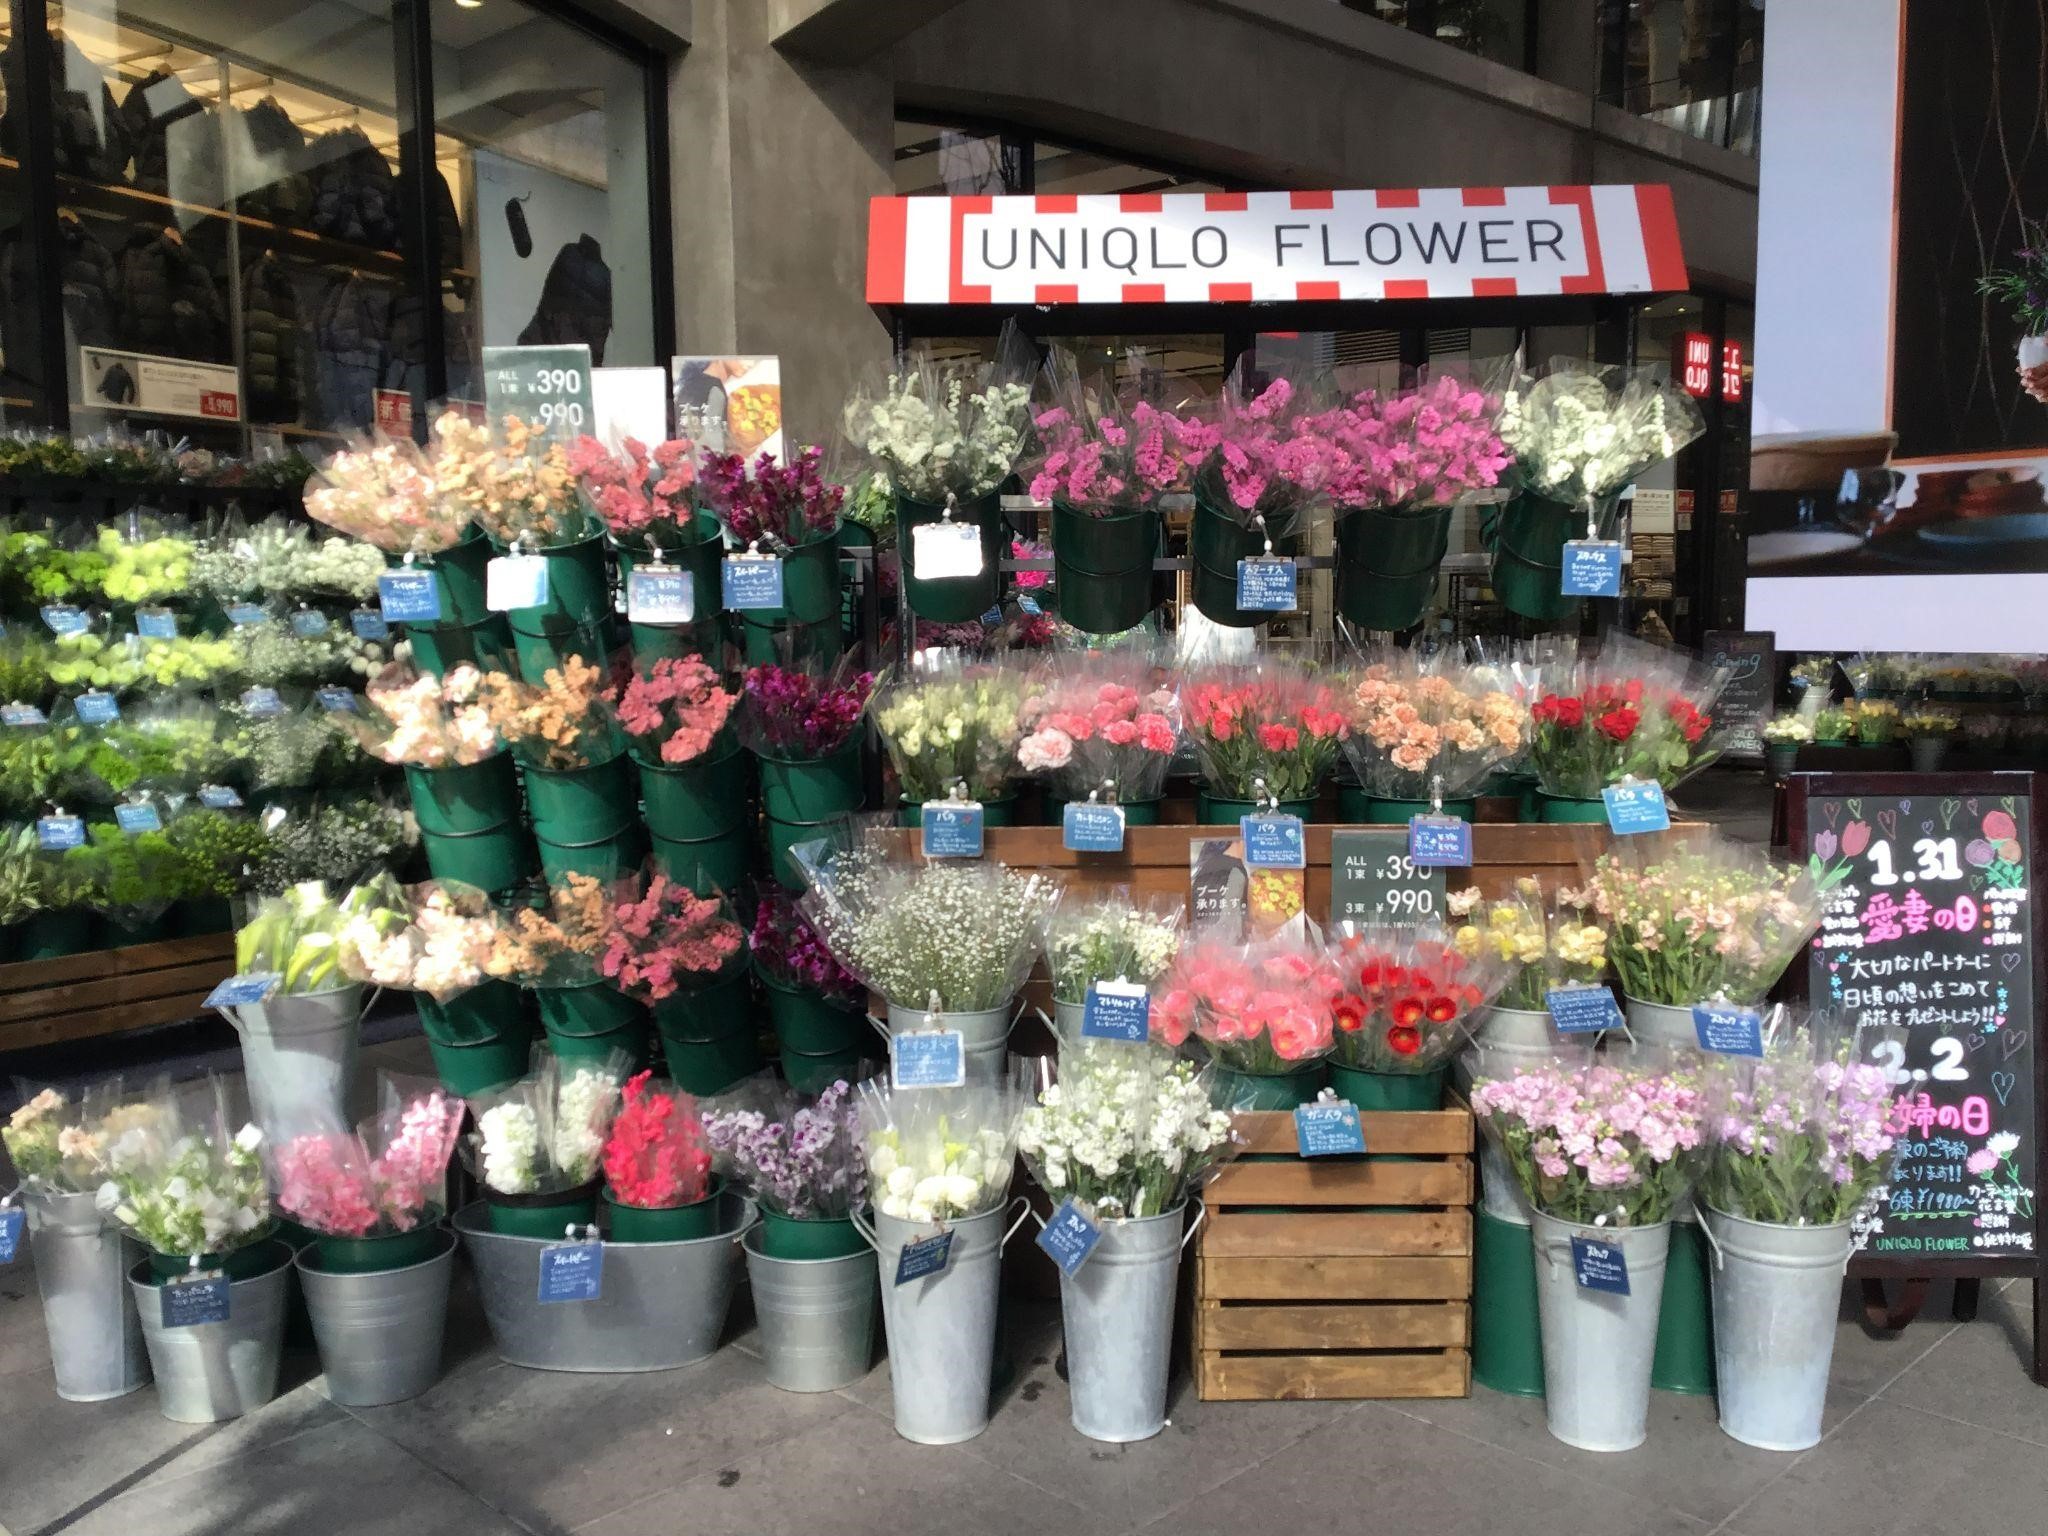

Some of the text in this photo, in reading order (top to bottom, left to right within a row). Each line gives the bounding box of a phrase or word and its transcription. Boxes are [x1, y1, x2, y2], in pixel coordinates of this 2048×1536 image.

[981, 218, 1567, 277] UNIQLO FLOWER
[498, 370, 519, 380] ALL
[528, 369, 580, 394] ¥390
[1345, 856, 1368, 866] ALL
[1346, 855, 1432, 880] 1束 ¥390
[1866, 838, 1964, 886] 1.31
[1196, 898, 1247, 910] 承ります。
[1197, 885, 1229, 898] ブーケ
[1345, 889, 1433, 914] 3束 ¥990
[1860, 888, 1978, 944] 愛妻の日
[1849, 950, 1992, 980] 大切なパートナーに
[1843, 979, 1990, 1009] 日頃の想いをこめて
[1871, 1037, 1970, 1085] 2.2
[1883, 1092, 1990, 1139] 婦の日
[1892, 1137, 1969, 1160] 束のご予約
[1876, 1237, 1922, 1251] UNIQLO
[1926, 1237, 1970, 1251] FLOWER
